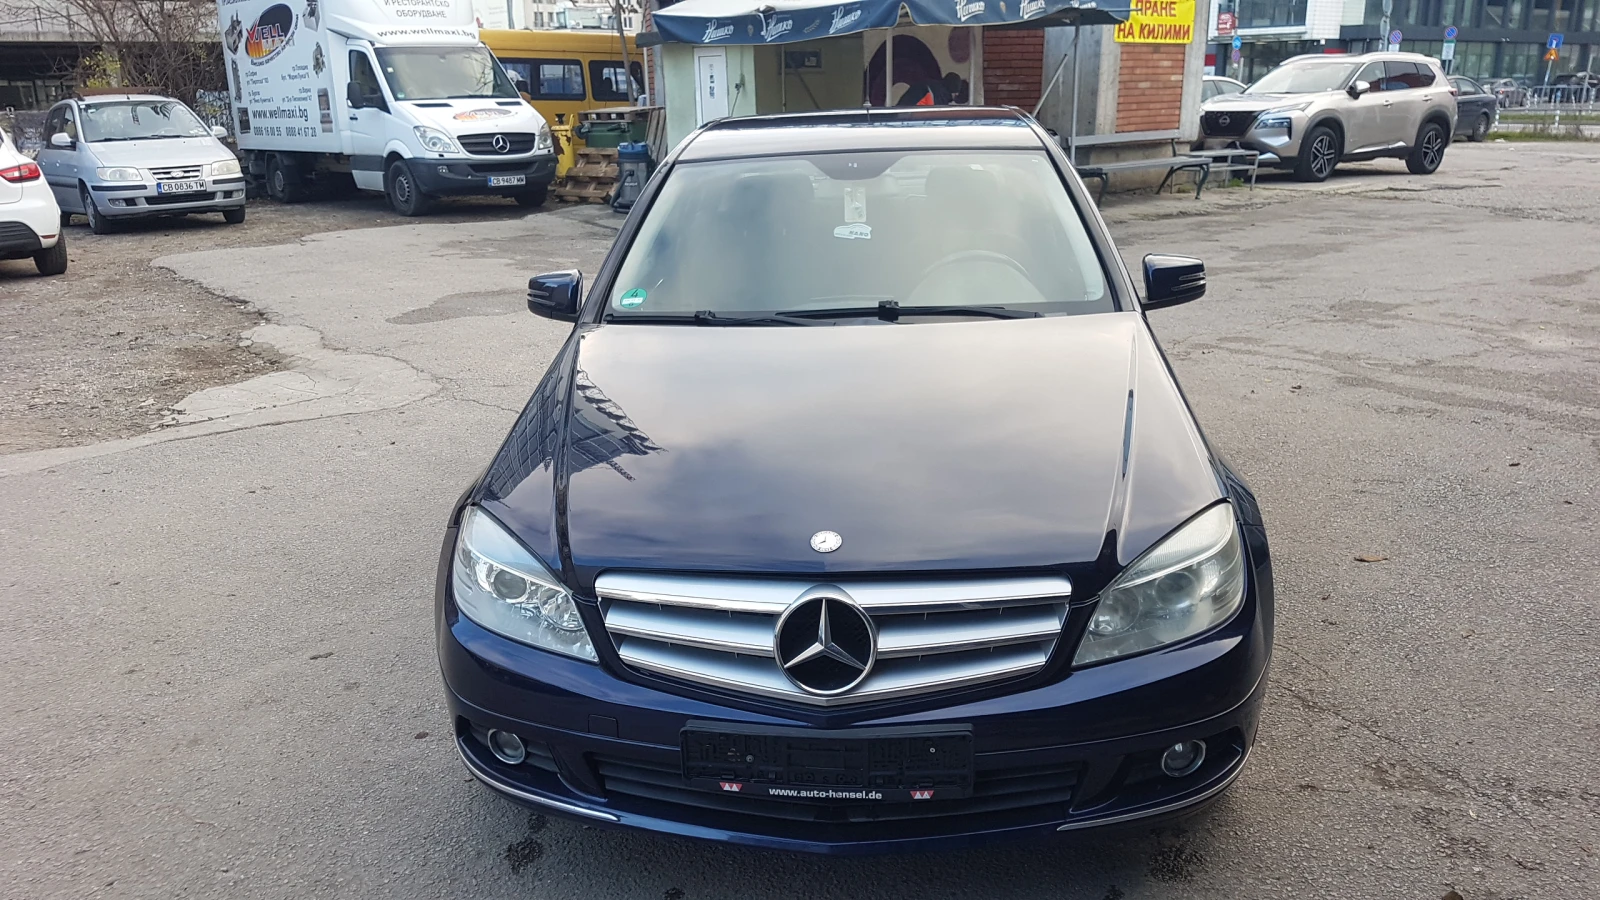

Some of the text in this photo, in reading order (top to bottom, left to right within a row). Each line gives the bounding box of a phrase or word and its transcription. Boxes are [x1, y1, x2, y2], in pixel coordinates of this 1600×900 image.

[396, 9, 447, 19] ОБОРУДВАНЕ
[1136, 0, 1177, 17] ПРАНЕ
[377, 28, 477, 40] www.wellmaxi.bg
[1117, 23, 1190, 41] НА КИЛИМИ
[252, 105, 308, 122] www.wellmaxi.bg
[276, 126, 282, 136] 55
[163, 181, 205, 191] CB 0836 TM
[769, 788, 882, 799] www.auto-hensel.de
